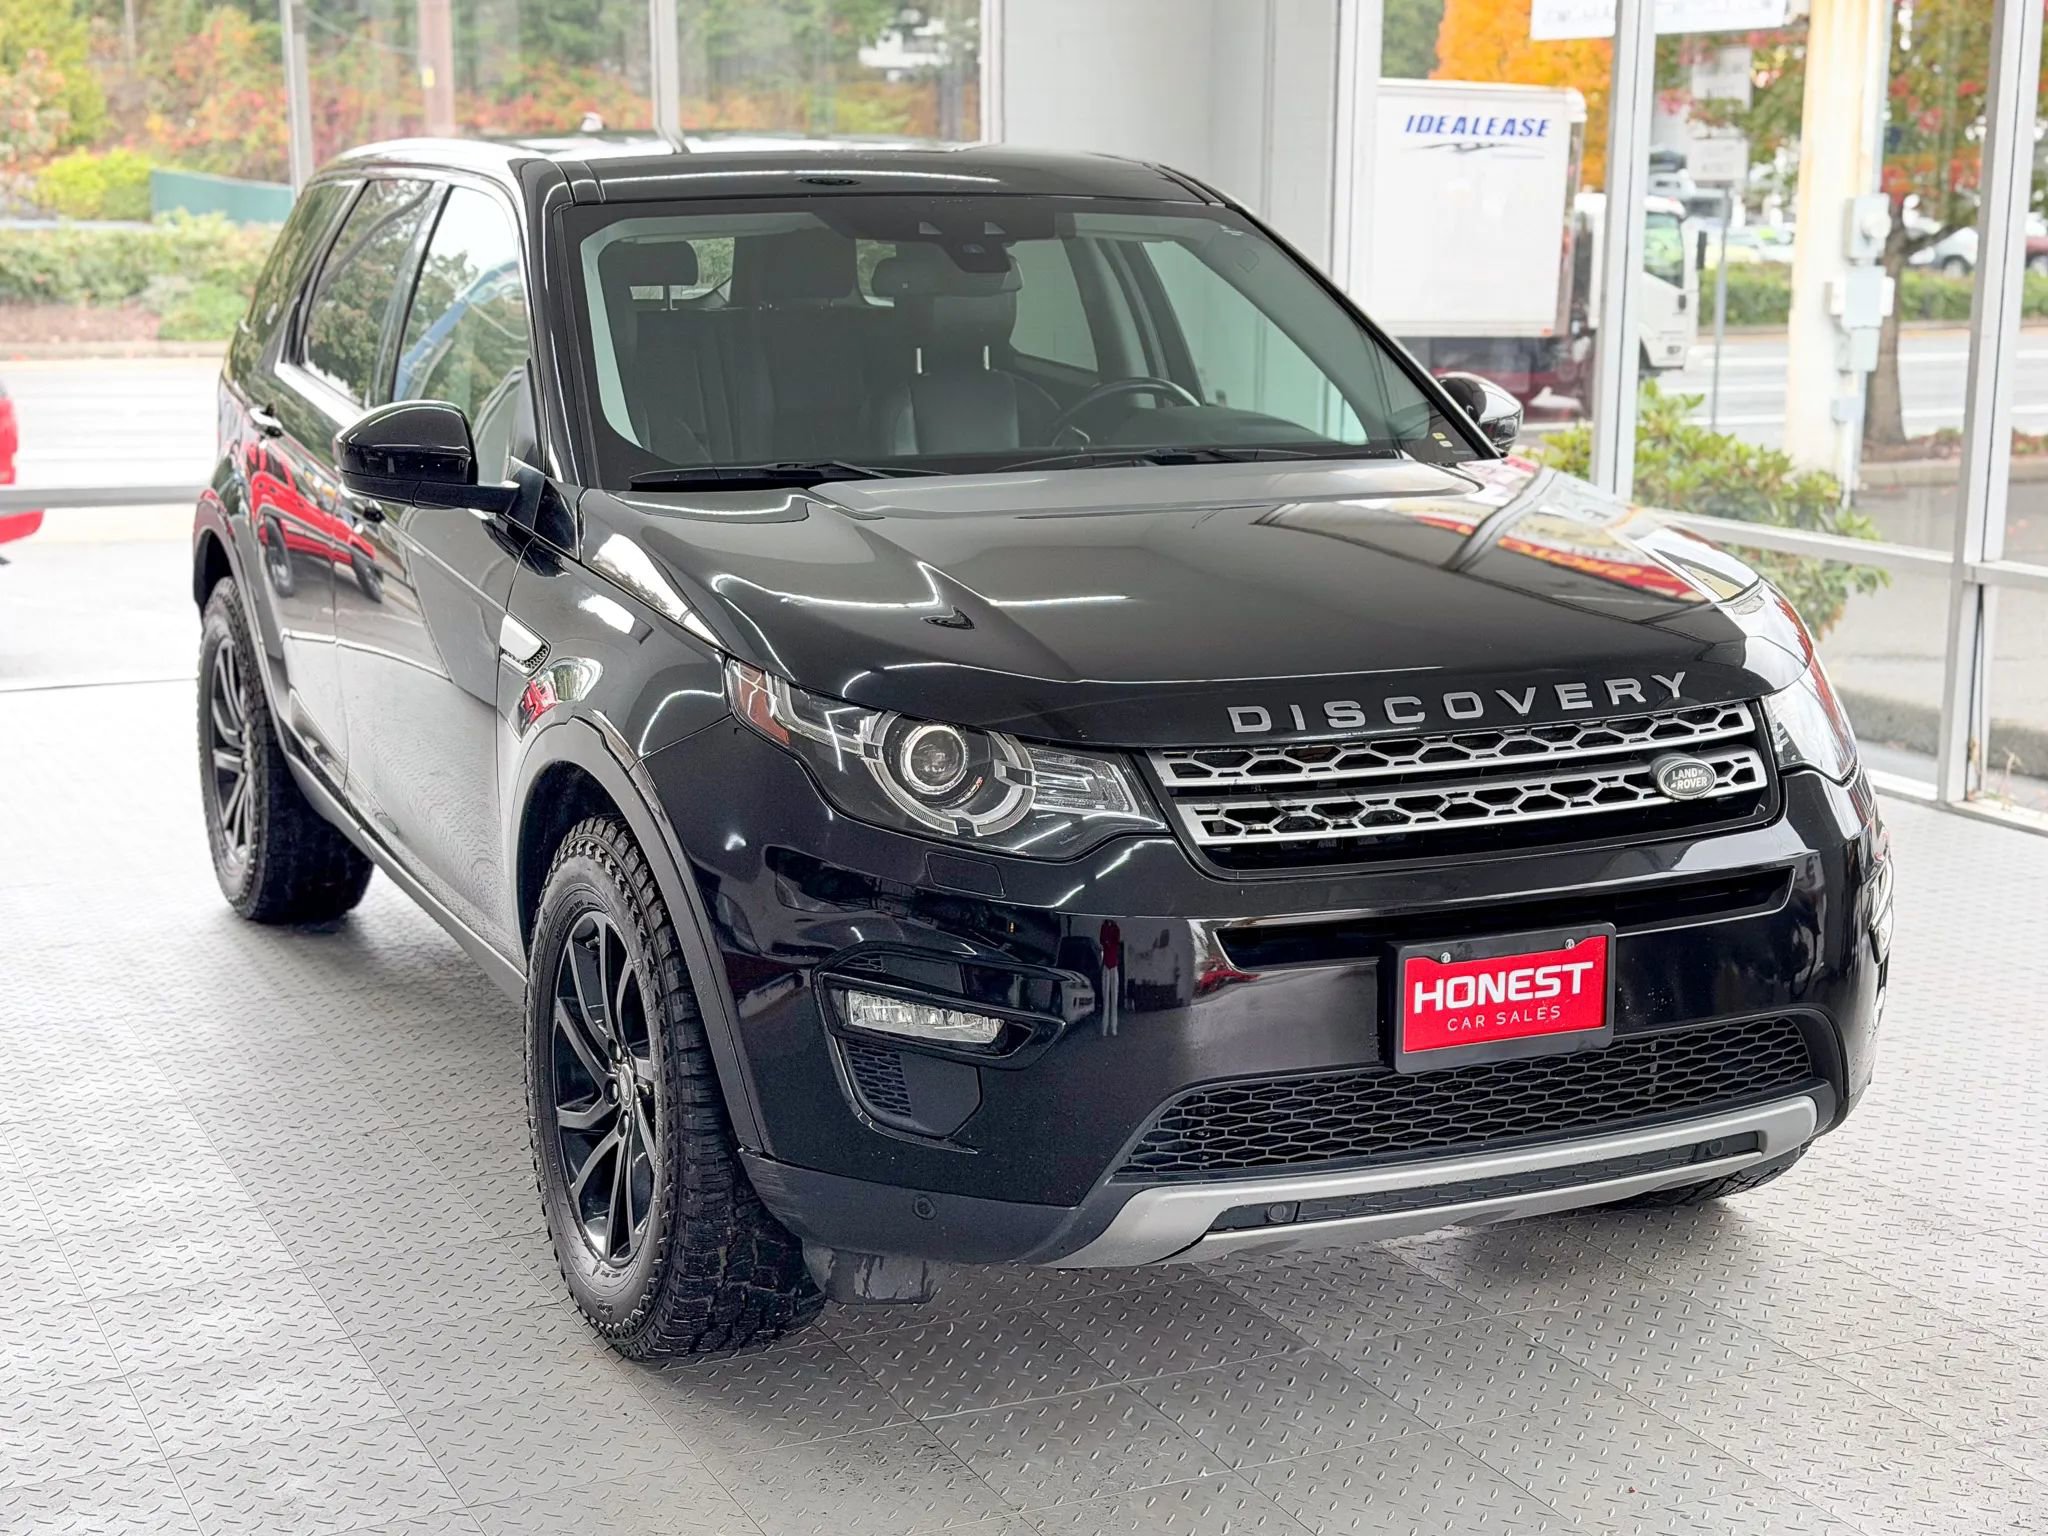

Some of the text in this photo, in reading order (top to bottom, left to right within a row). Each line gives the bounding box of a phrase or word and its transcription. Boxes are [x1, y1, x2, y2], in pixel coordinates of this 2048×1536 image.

[1405, 114, 1551, 137] IDEALEASE
[1227, 671, 1686, 734] DISCOVERY
[1672, 767, 1698, 780] LAND
[1676, 776, 1708, 791] ROVER
[1413, 961, 1594, 1014] HONEST
[1447, 1005, 1561, 1031] CAR SALES
